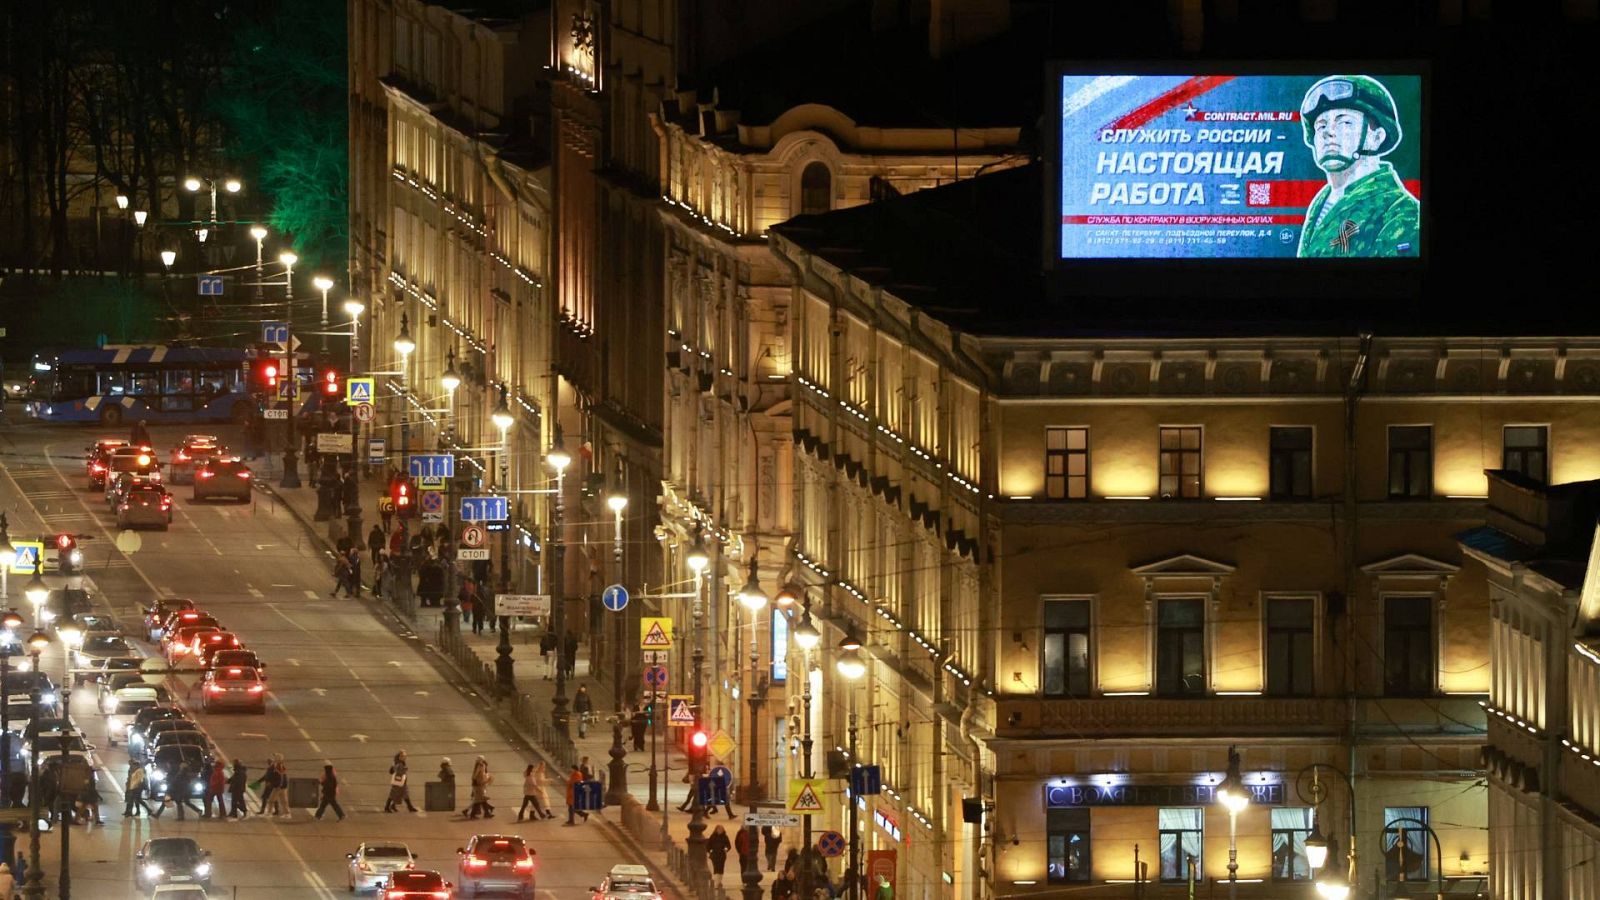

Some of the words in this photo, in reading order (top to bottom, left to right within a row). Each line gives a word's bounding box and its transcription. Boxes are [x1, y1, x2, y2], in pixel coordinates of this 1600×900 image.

[1203, 112, 1293, 121] CONTRACT.MIL.RU
[1101, 128, 1192, 143] СЛУЖИТЬ
[1197, 129, 1272, 143] РОССИИ
[1097, 151, 1285, 178] НАСТОЯЩАЯ
[1090, 182, 1206, 206] РАБОТА
[1087, 216, 1120, 224] СЛУЖБА
[1121, 216, 1133, 224] ПО
[1134, 216, 1179, 224] КОНТРАКТУ
[1186, 216, 1245, 224] ВООРУЖЕННЫХ
[1246, 216, 1273, 224] СИЛАХ
[462, 550, 485, 559] СТОП
